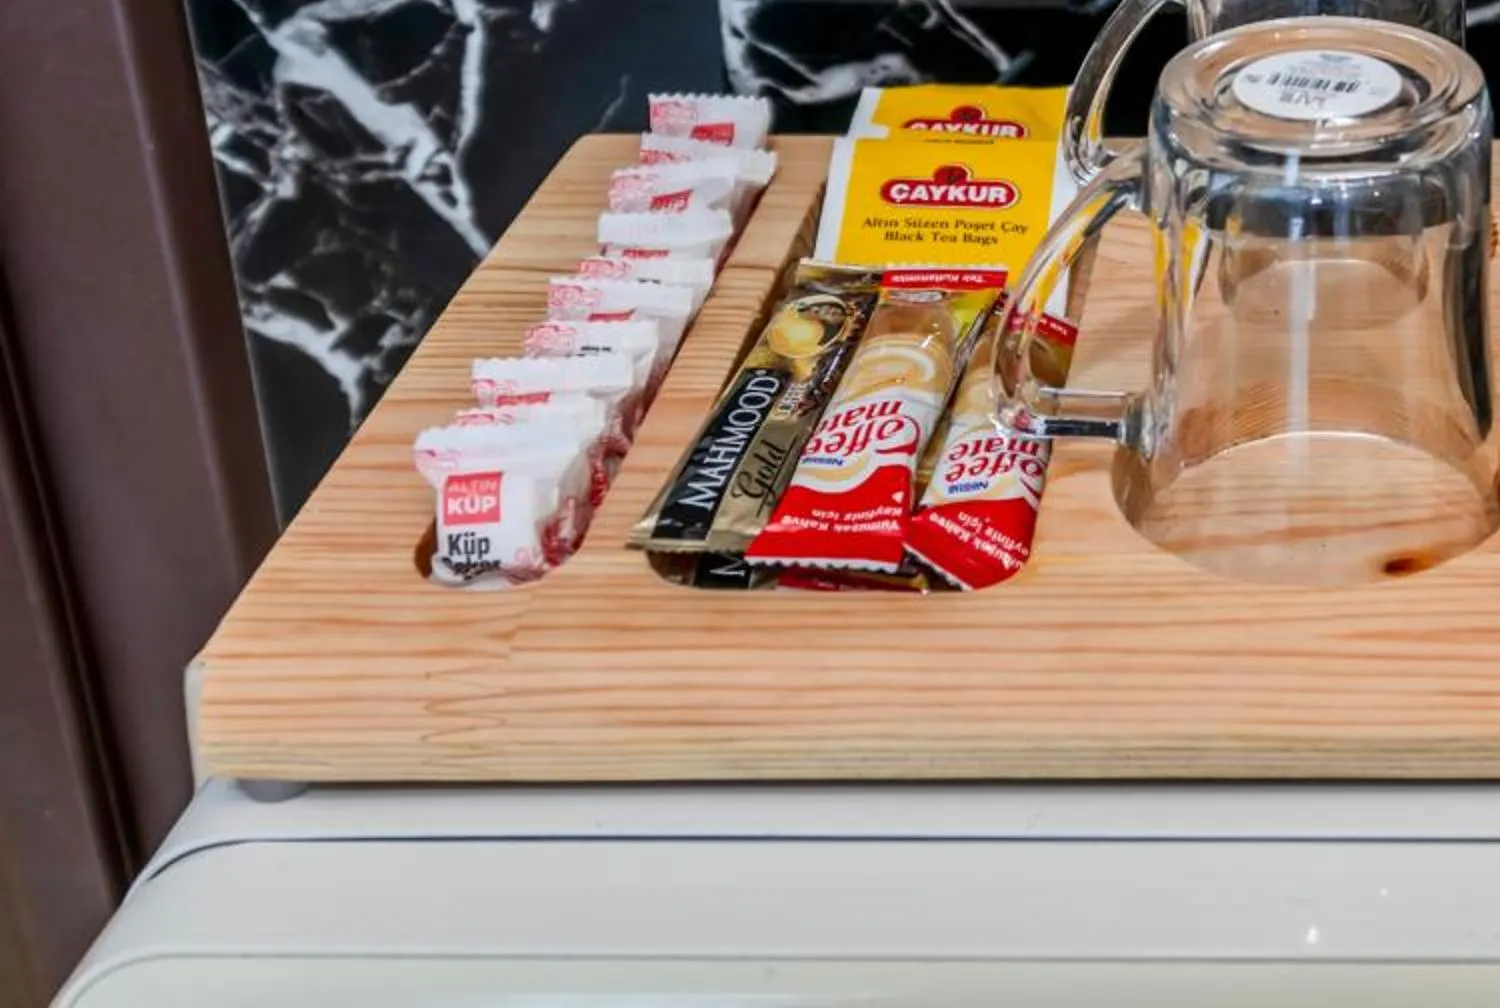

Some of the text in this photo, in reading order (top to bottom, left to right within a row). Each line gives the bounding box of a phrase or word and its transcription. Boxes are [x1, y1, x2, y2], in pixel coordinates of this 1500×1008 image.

[889, 183, 1008, 204] ÇAYKUR
[883, 230, 999, 247] Black Tea Bags
[676, 374, 781, 512] MAHMOOD
[731, 437, 790, 510] Gold
[447, 531, 491, 559] Küp
